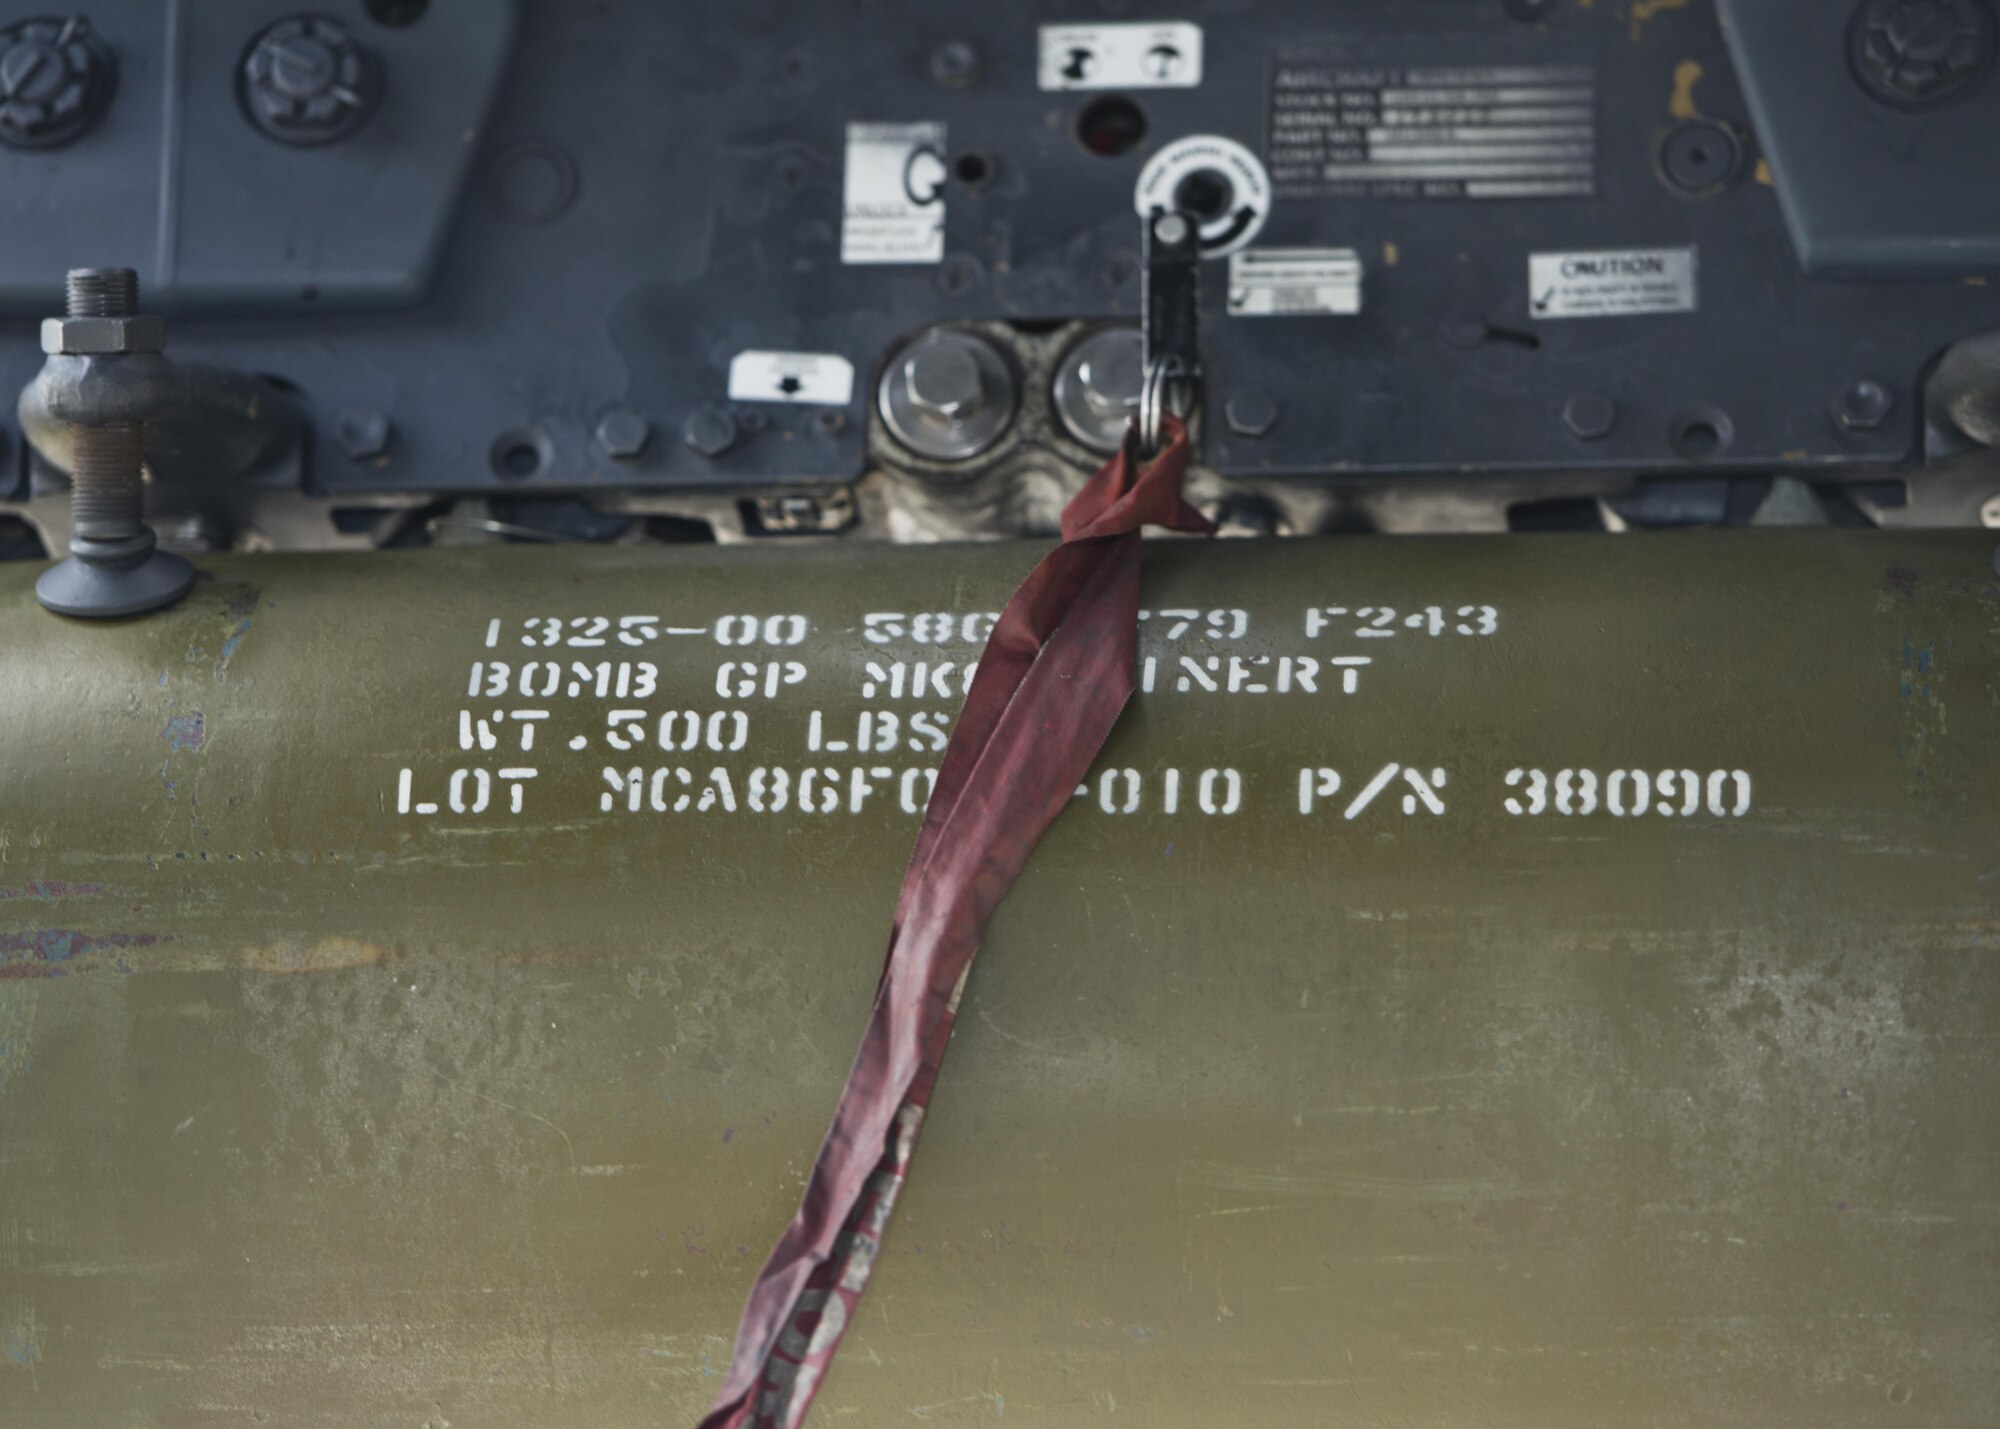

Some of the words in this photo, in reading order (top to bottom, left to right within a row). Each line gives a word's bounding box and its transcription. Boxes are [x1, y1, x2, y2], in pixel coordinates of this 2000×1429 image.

[1561, 257, 1664, 279] CAUTION
[485, 614, 808, 648] 1325-00
[1305, 605, 1498, 639] F243
[467, 660, 659, 699] BOMB
[715, 660, 808, 699] GP
[1142, 655, 1373, 695] INERT
[807, 709, 950, 753] LBS
[397, 767, 539, 815] LOT
[1298, 762, 1447, 820] P/N
[1503, 767, 1751, 817] 38090
